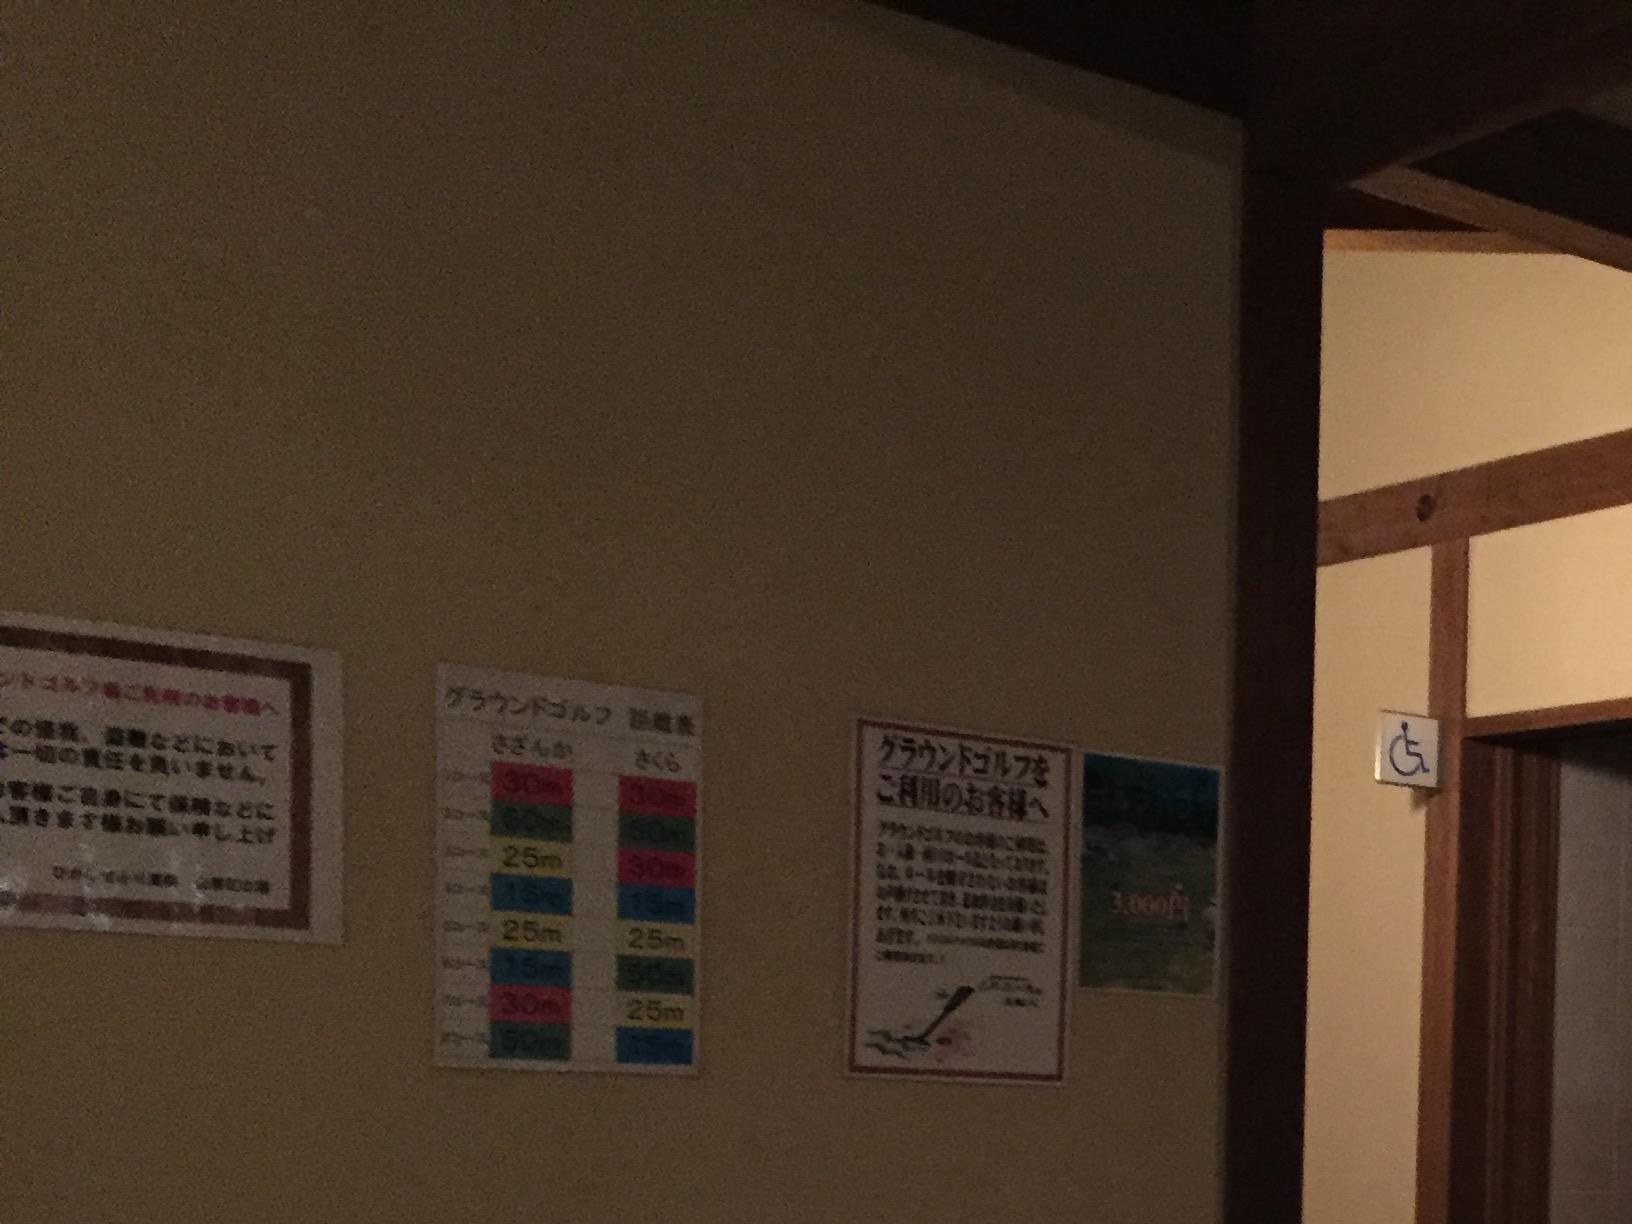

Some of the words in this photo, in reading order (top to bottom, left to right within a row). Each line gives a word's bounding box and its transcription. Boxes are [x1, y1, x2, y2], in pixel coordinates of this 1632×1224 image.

[446, 686, 611, 724] グラウンドゴルフ
[634, 748, 683, 772] さくら
[880, 734, 1050, 788] グラウンドゴルフを
[501, 769, 564, 797] 30m
[629, 783, 688, 808] 30m
[877, 773, 1049, 821] ご利用のお客様へ
[502, 845, 563, 869] 25m
[502, 919, 563, 944] 25m
[628, 927, 686, 950] 25m
[505, 956, 564, 980] 15m
[502, 992, 563, 1016] 30m
[627, 1000, 685, 1022] 25m
